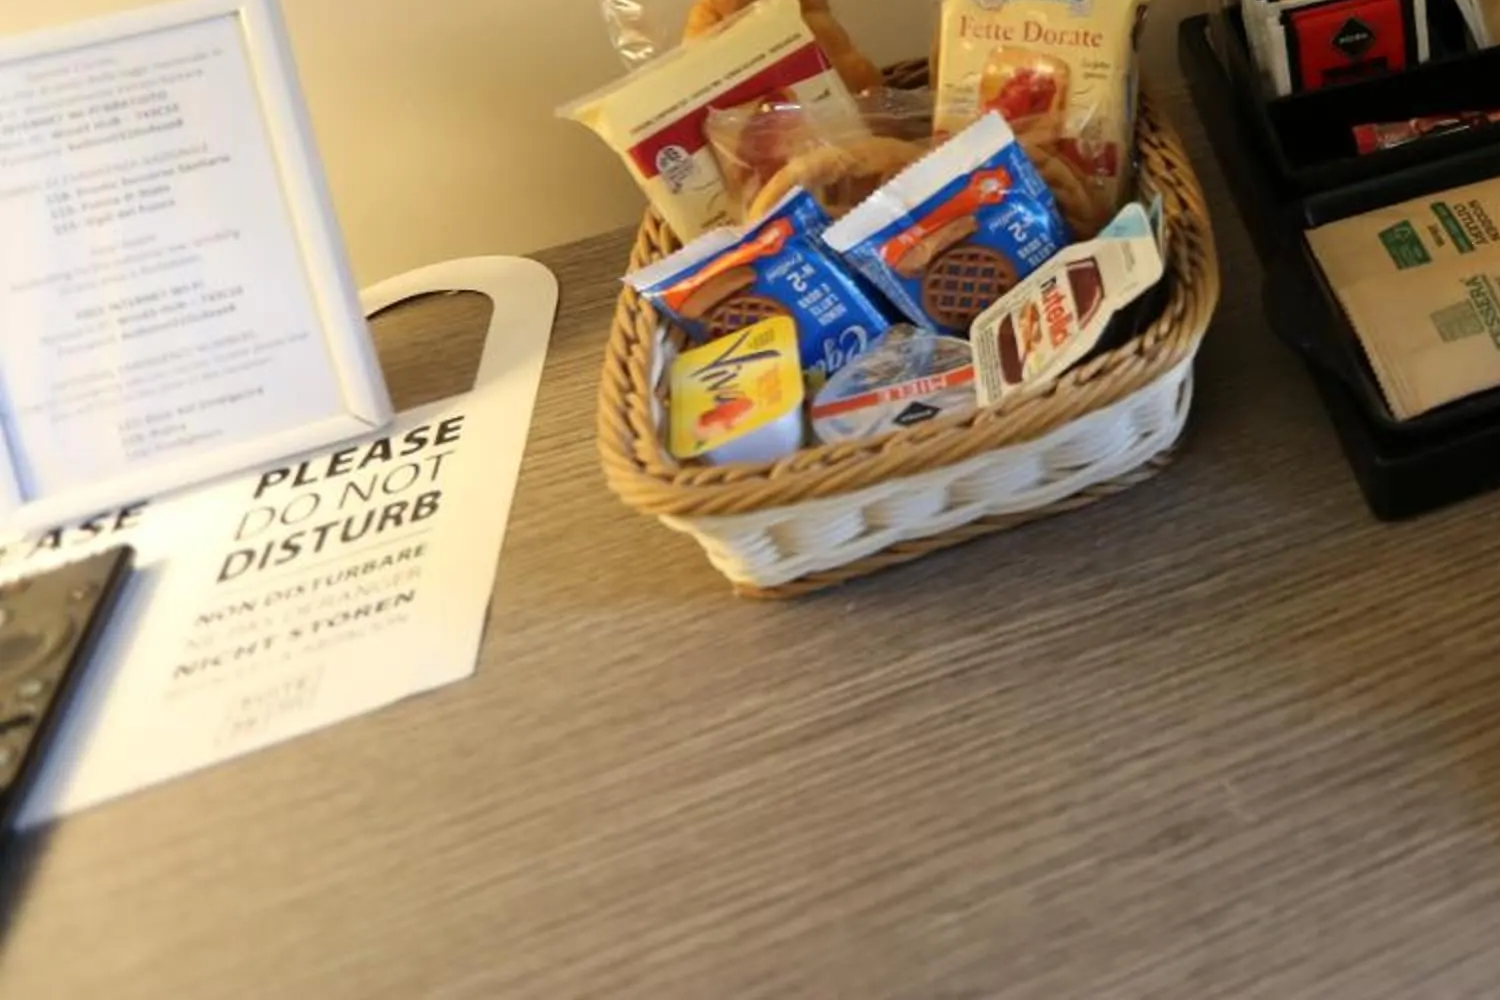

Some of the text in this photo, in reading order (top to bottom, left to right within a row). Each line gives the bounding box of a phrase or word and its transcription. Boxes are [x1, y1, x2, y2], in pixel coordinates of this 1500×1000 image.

[958, 14, 1104, 47] Fette Dorate
[1040, 275, 1073, 349] nutella
[234, 449, 456, 542] DO NOT
[253, 414, 466, 500] PLEASE
[216, 489, 443, 584] DISTURB
[263, 543, 428, 607] DISTURBARE
